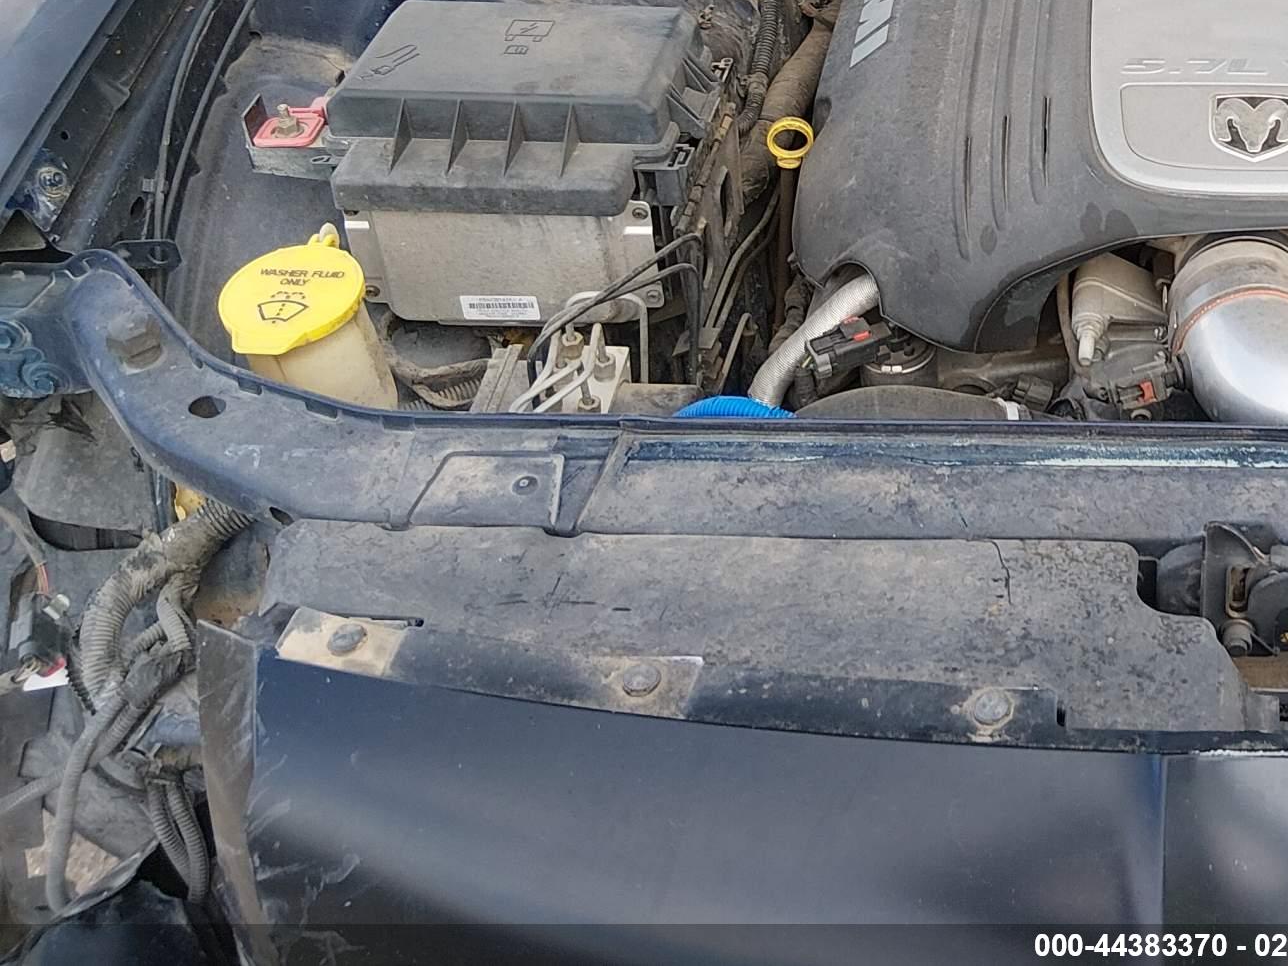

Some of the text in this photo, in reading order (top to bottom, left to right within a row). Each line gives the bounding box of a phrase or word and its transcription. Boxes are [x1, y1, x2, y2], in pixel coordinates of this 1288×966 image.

[1120, 57, 1268, 75] 5.7L
[260, 268, 344, 279] WASHER FLUID
[279, 278, 311, 287] ONLY
